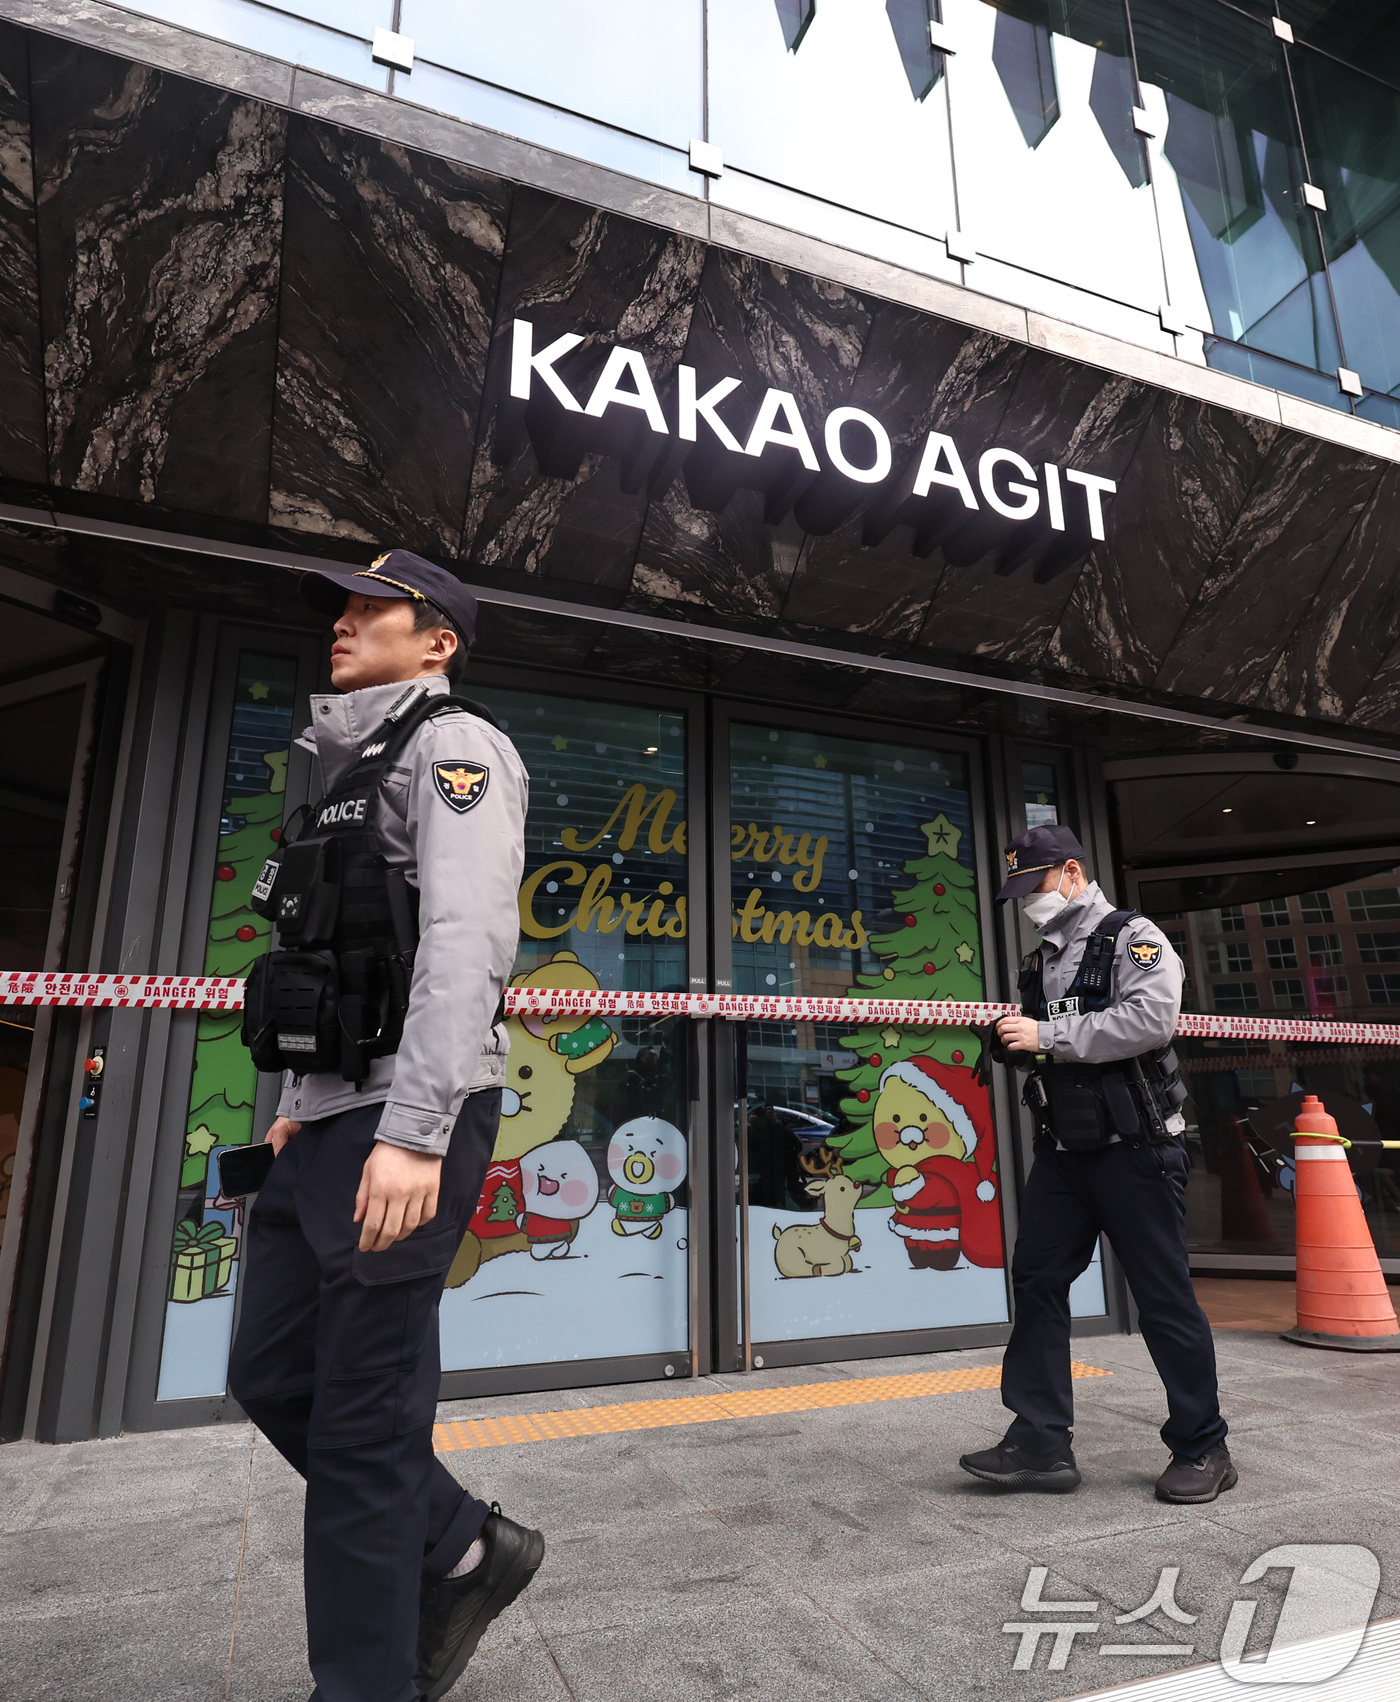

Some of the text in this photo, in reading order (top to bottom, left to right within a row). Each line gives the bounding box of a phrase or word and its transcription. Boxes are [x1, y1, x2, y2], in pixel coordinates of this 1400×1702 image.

[510, 318, 1117, 541] KAKAO AGIT
[316, 799, 367, 828] POLICE
[255, 884, 269, 896] POLICE
[7, 981, 229, 999] 危險 안전제일 DANGER 위험
[551, 996, 591, 1008] DANGER
[598, 998, 617, 1009] 위험
[626, 999, 645, 1009] 危險
[651, 1000, 688, 1011] 안전제일
[718, 1002, 755, 1012] DANGER
[760, 1003, 777, 1013] 위험
[807, 1004, 841, 1015] 안전제일
[868, 1006, 900, 1016] DANGER
[905, 1007, 920, 1017] 위험
[947, 1009, 977, 1019] 안전제일
[1231, 1023, 1255, 1032] DANGER
[1330, 1028, 1352, 1036] DANGER
